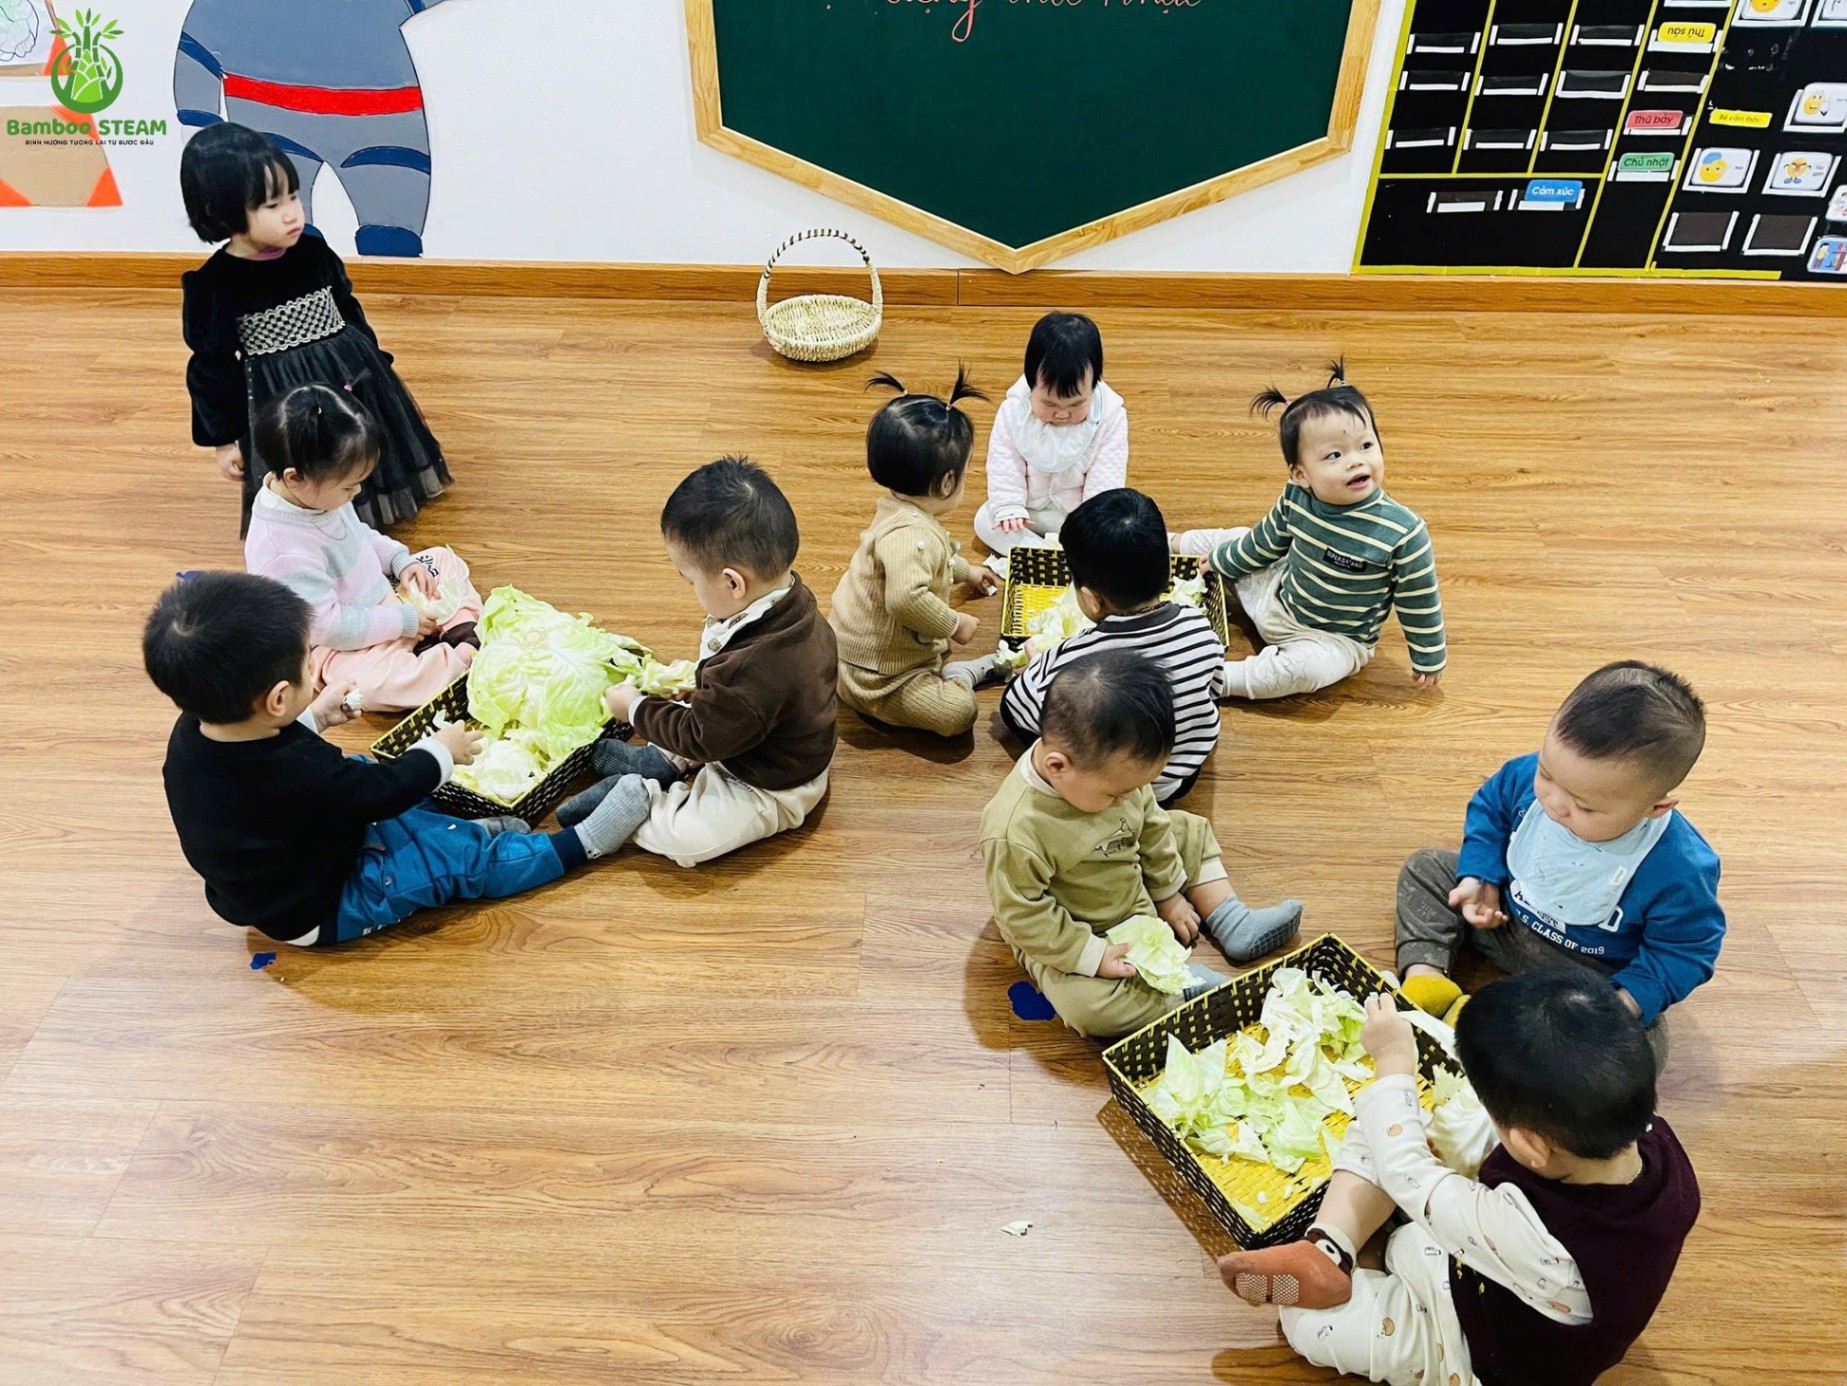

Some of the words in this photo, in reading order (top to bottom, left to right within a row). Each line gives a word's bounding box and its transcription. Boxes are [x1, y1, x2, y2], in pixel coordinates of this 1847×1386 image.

[1634, 114, 1652, 124] Thứ
[1653, 113, 1673, 125] bảy
[1623, 156, 1644, 167] Chủ
[1645, 157, 1669, 168] nhật
[1532, 185, 1555, 196] Cảm
[1556, 186, 1575, 196] xúc
[1531, 920, 1565, 945] CLASS
[1564, 938, 1579, 951] OF
[1580, 945, 1605, 956] 2019
